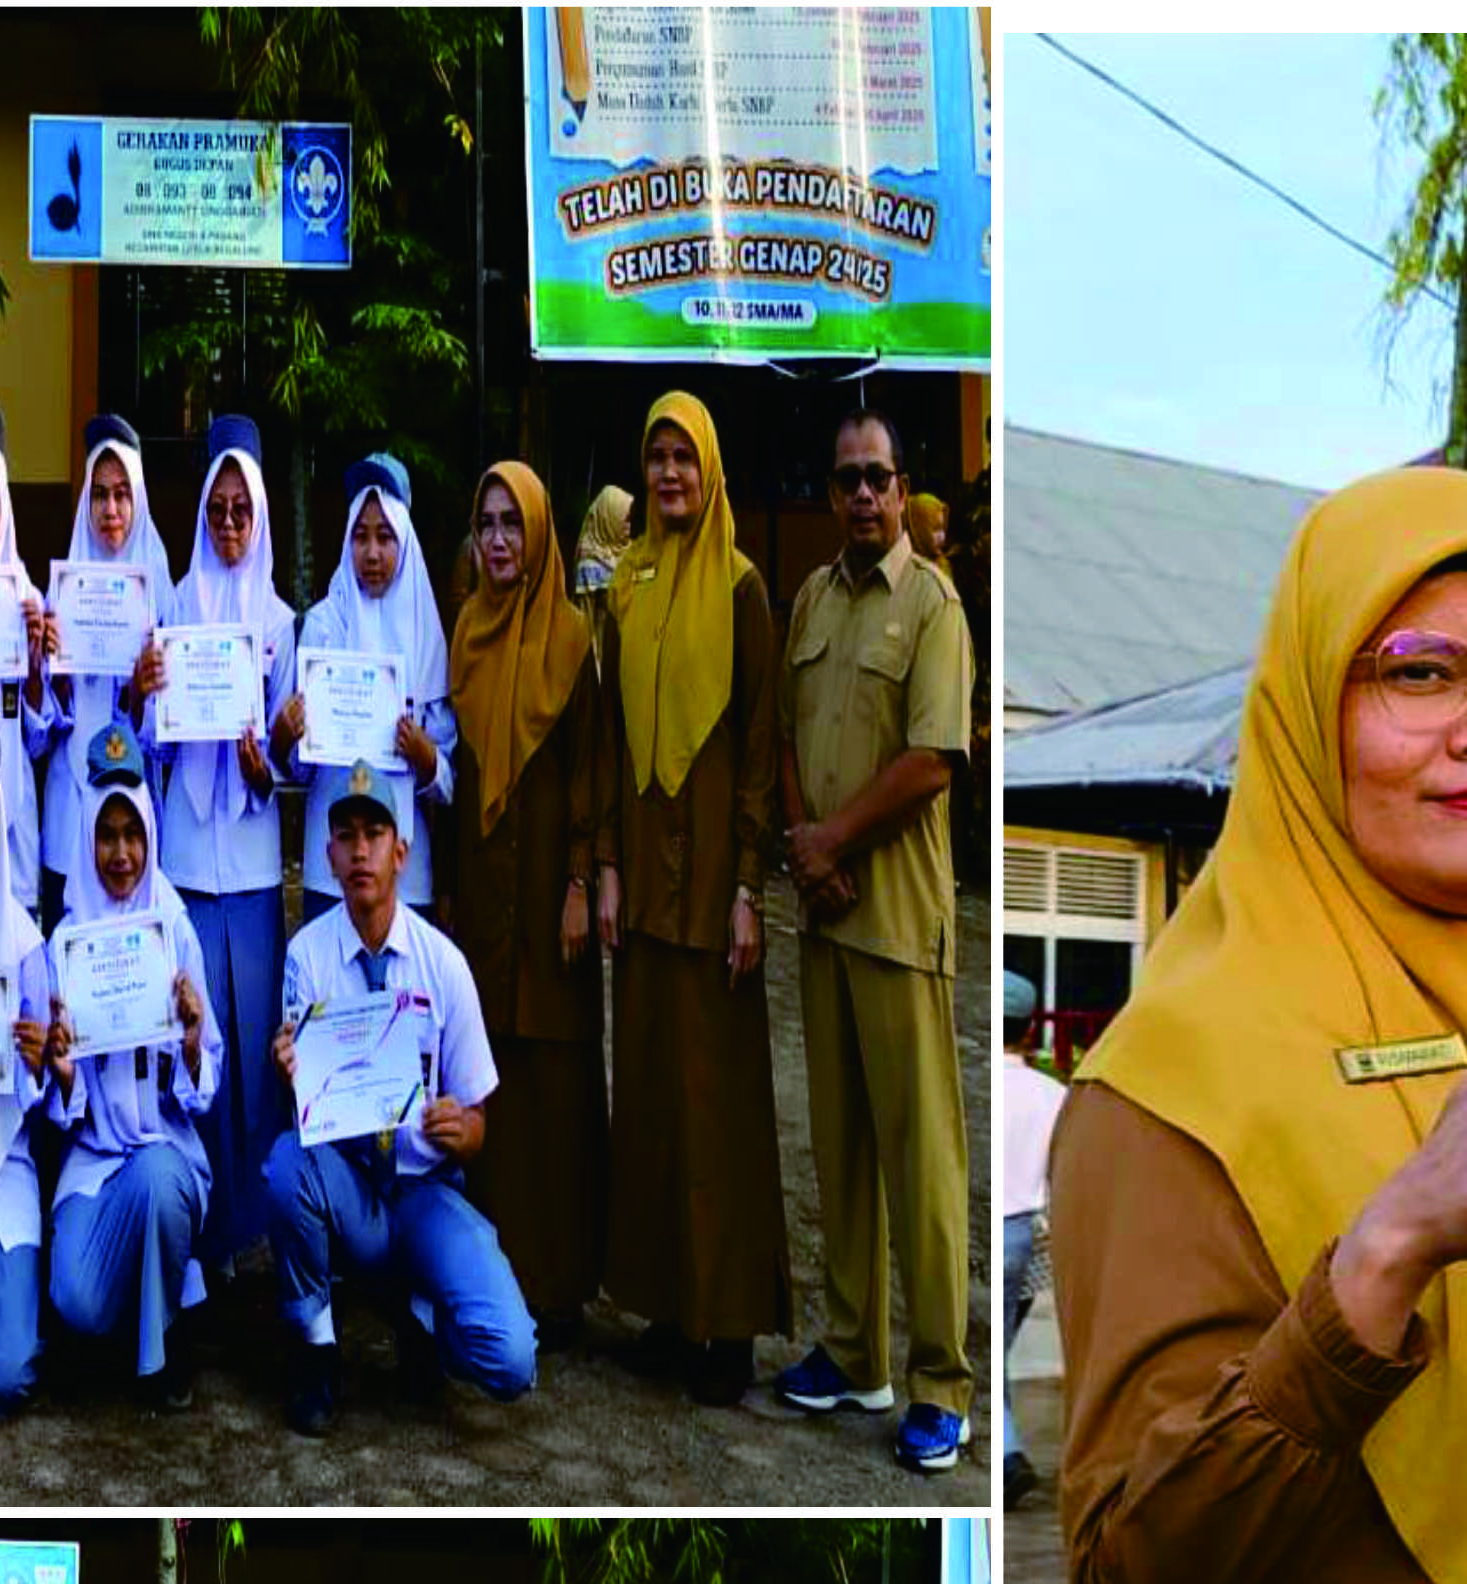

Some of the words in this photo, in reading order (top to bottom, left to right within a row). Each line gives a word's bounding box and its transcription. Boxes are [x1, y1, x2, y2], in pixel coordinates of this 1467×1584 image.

[564, 178, 644, 231] TELAH
[651, 172, 678, 208] DI
[756, 169, 935, 241] PENDAFTARAN
[610, 238, 735, 287] SEMESTER
[739, 240, 823, 275] GENAP
[827, 248, 888, 295] 24/25
[747, 302, 804, 320] SMA/MA
